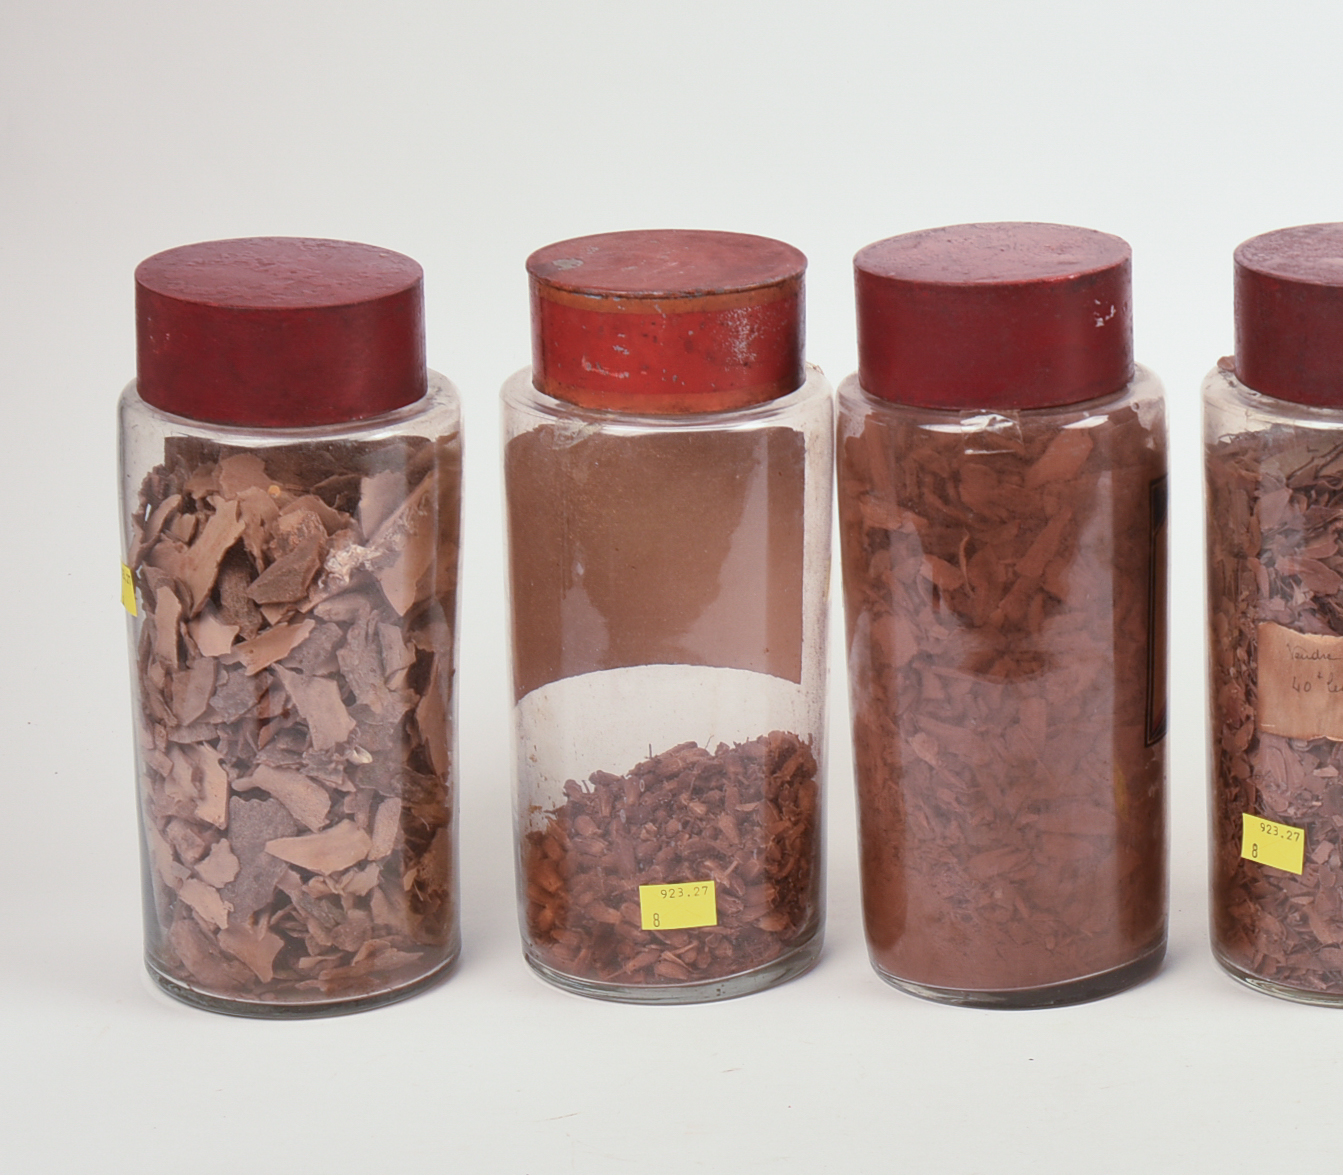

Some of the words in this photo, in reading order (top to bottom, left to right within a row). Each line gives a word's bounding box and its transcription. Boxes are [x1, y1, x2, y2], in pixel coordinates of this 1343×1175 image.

[1260, 822, 1300, 842] 923.27
[1251, 843, 1258, 858] 8
[660, 886, 708, 899] 923.27
[653, 913, 660, 927] 8
